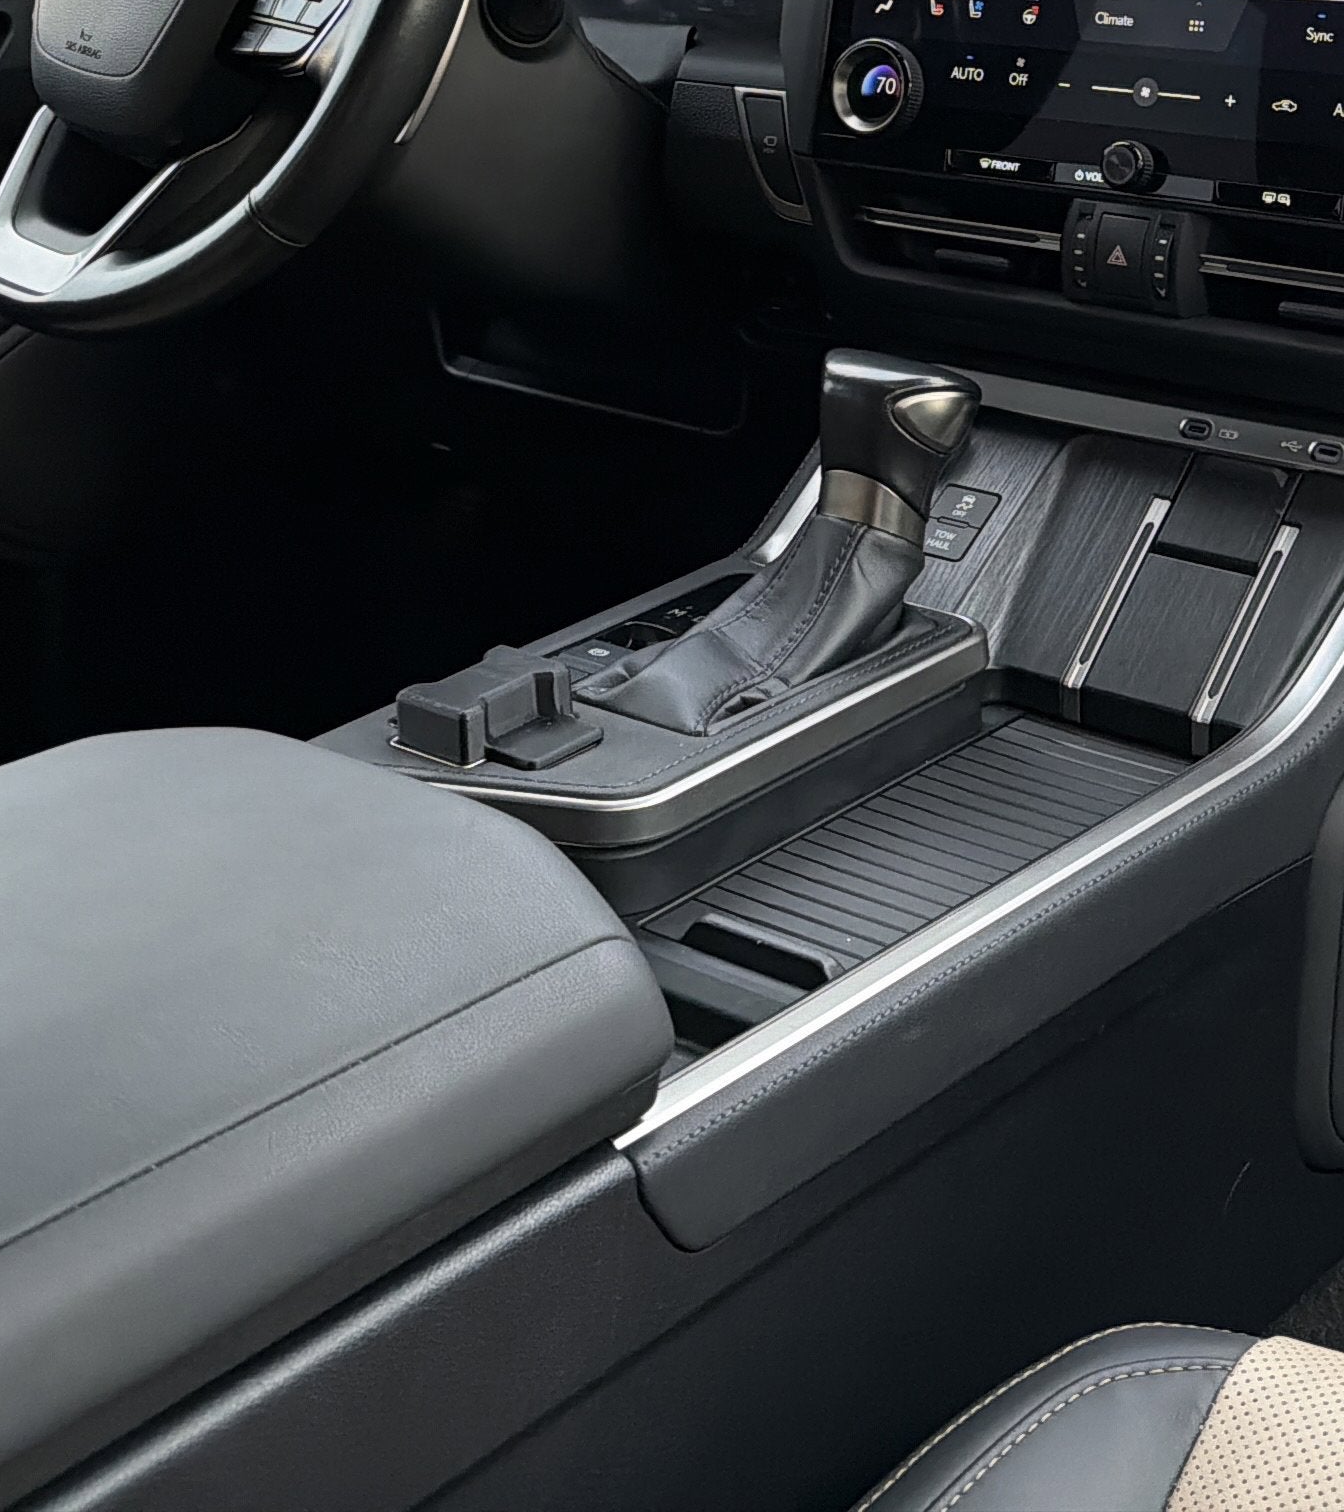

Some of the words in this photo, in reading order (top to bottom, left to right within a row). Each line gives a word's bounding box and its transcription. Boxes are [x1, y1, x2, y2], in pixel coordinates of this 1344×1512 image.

[1094, 11, 1134, 28] Climate
[1305, 26, 1334, 44] Sync
[950, 66, 985, 82] AUTO
[1008, 71, 1029, 88] Off
[875, 76, 897, 96] 70
[990, 160, 1020, 174] FRONT
[1085, 171, 1104, 183] VOL
[951, 509, 967, 518] OFF
[935, 529, 958, 541] TOW
[925, 537, 951, 551] HAUL
